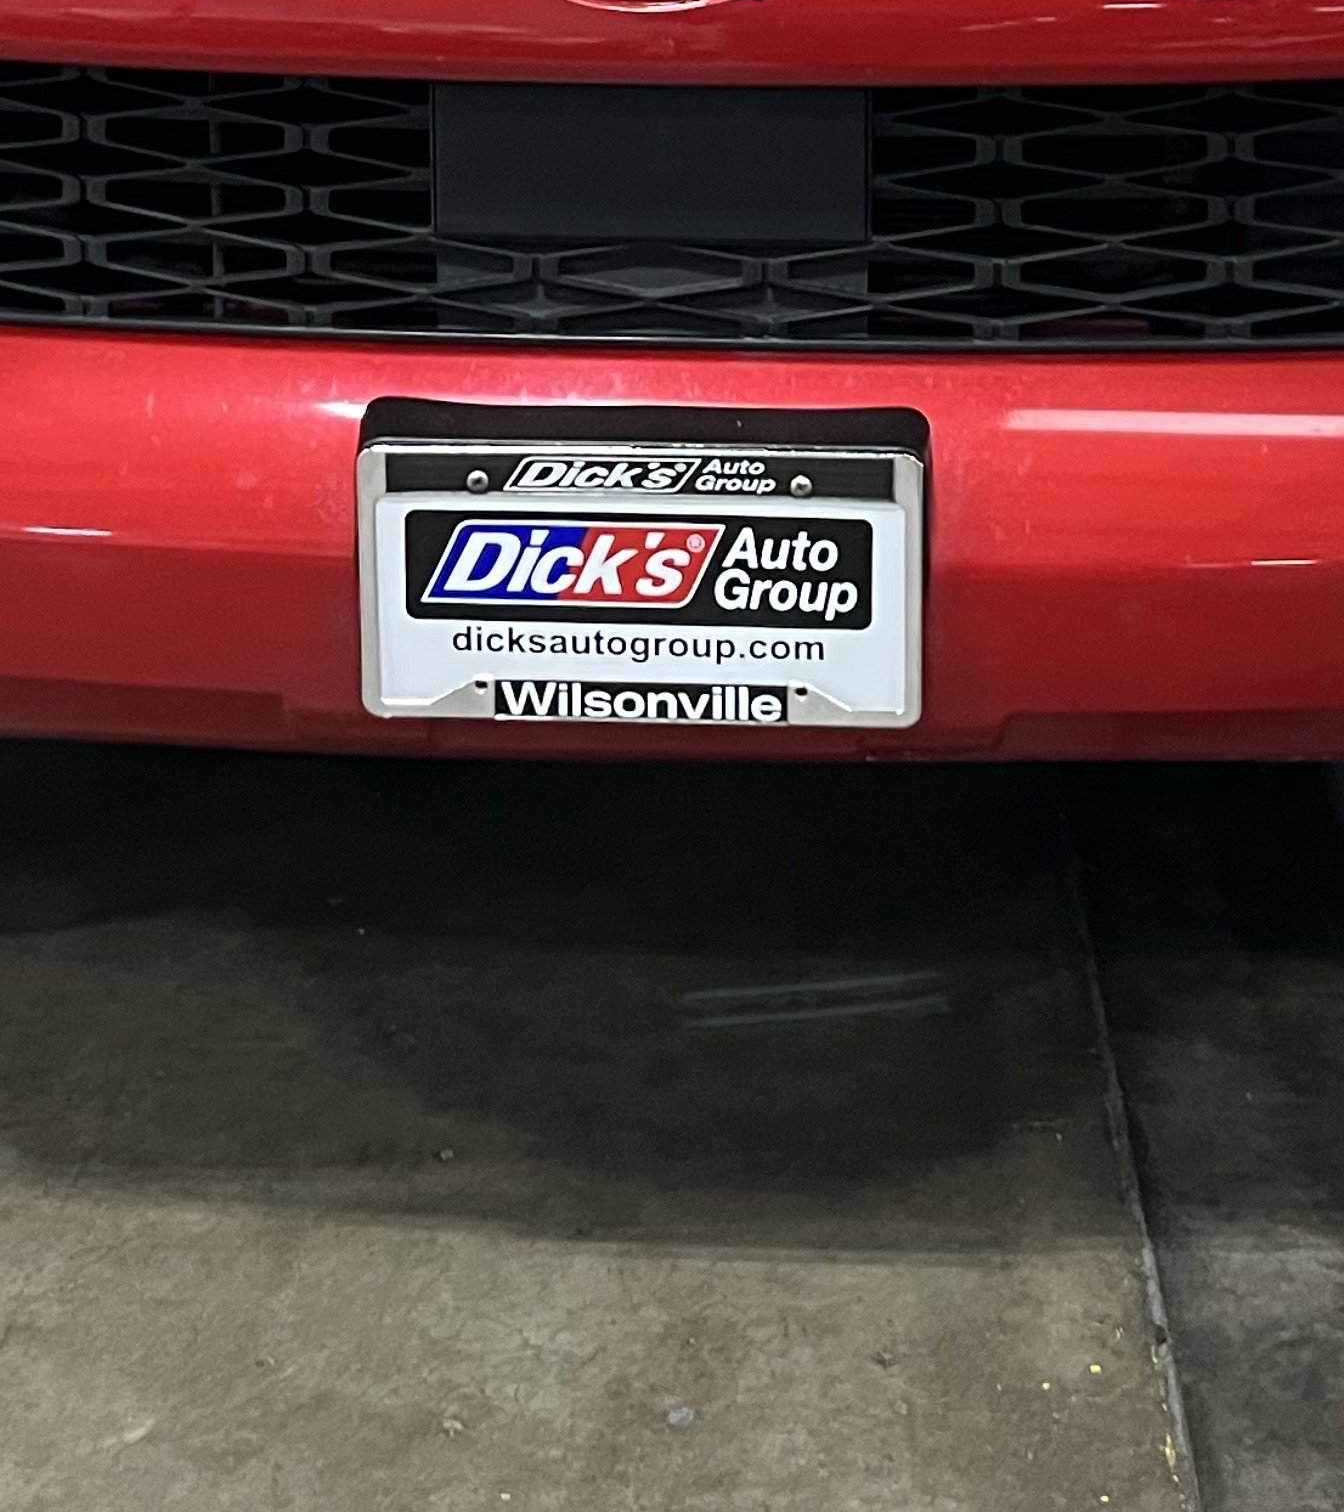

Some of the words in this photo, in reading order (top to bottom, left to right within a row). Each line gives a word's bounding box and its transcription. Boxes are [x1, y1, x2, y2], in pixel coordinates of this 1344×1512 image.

[519, 461, 676, 489] Dick's
[695, 476, 776, 494] Group
[703, 458, 766, 476] Auto
[444, 529, 690, 596] Dick's
[723, 527, 838, 571] Auto
[715, 570, 858, 621] Group
[453, 627, 825, 664] dicksautogroup.com
[500, 680, 783, 723] Wilsonville
